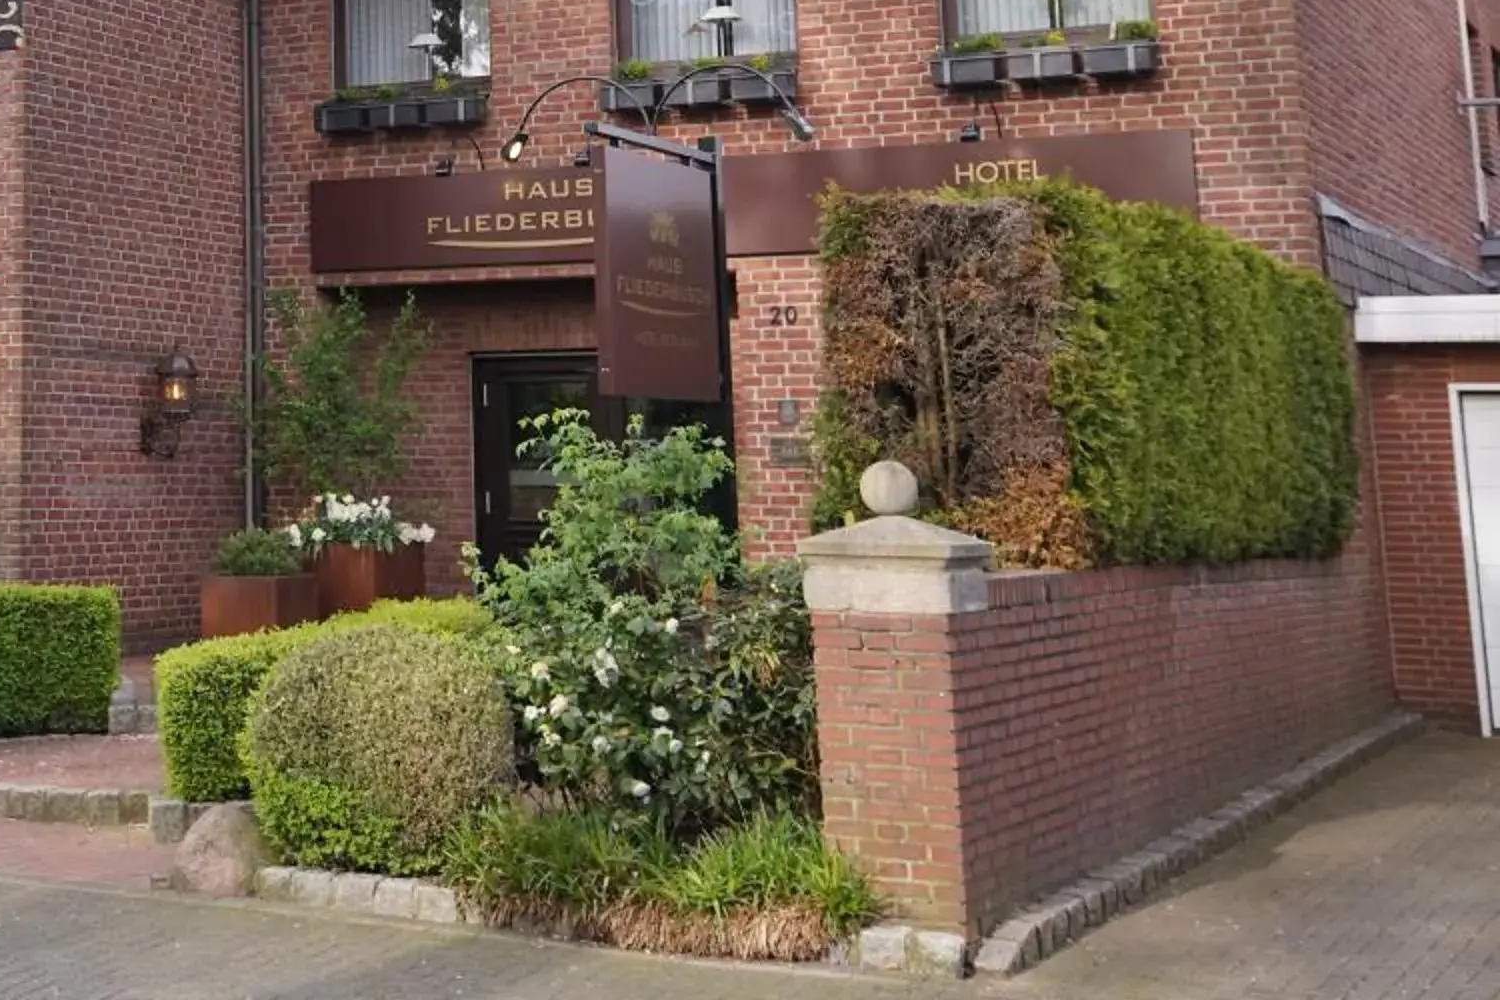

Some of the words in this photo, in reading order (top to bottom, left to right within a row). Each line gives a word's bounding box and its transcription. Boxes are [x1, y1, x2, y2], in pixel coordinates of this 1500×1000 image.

[954, 158, 1047, 185] HOTEL
[504, 177, 593, 200] HAUS
[769, 305, 798, 326] 20
